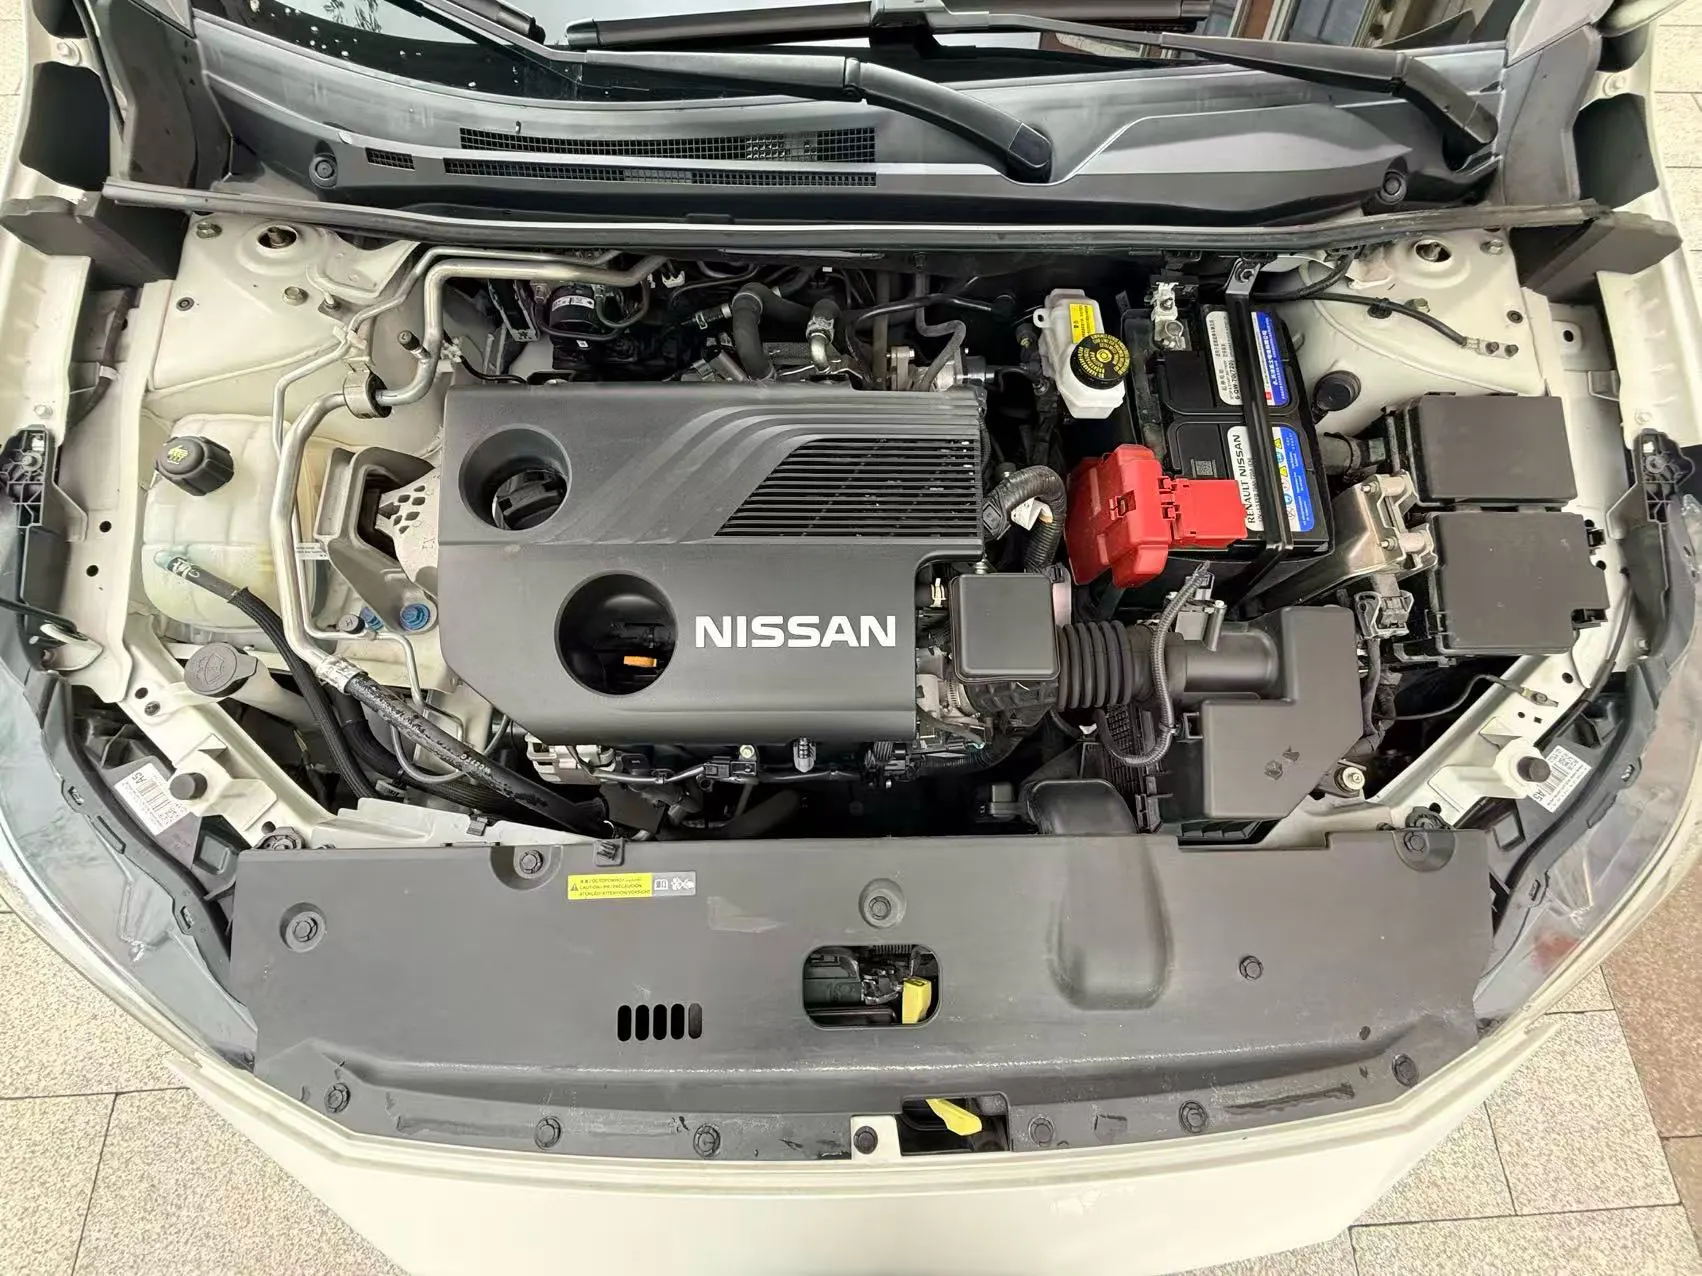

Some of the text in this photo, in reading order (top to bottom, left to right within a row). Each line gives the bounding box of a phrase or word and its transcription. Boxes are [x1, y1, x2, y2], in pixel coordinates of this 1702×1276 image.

[1233, 434, 1256, 524] RENAULT NISSAN
[695, 615, 896, 648] NISSAN
[132, 772, 147, 784] A5
[1533, 789, 1546, 801] A5
